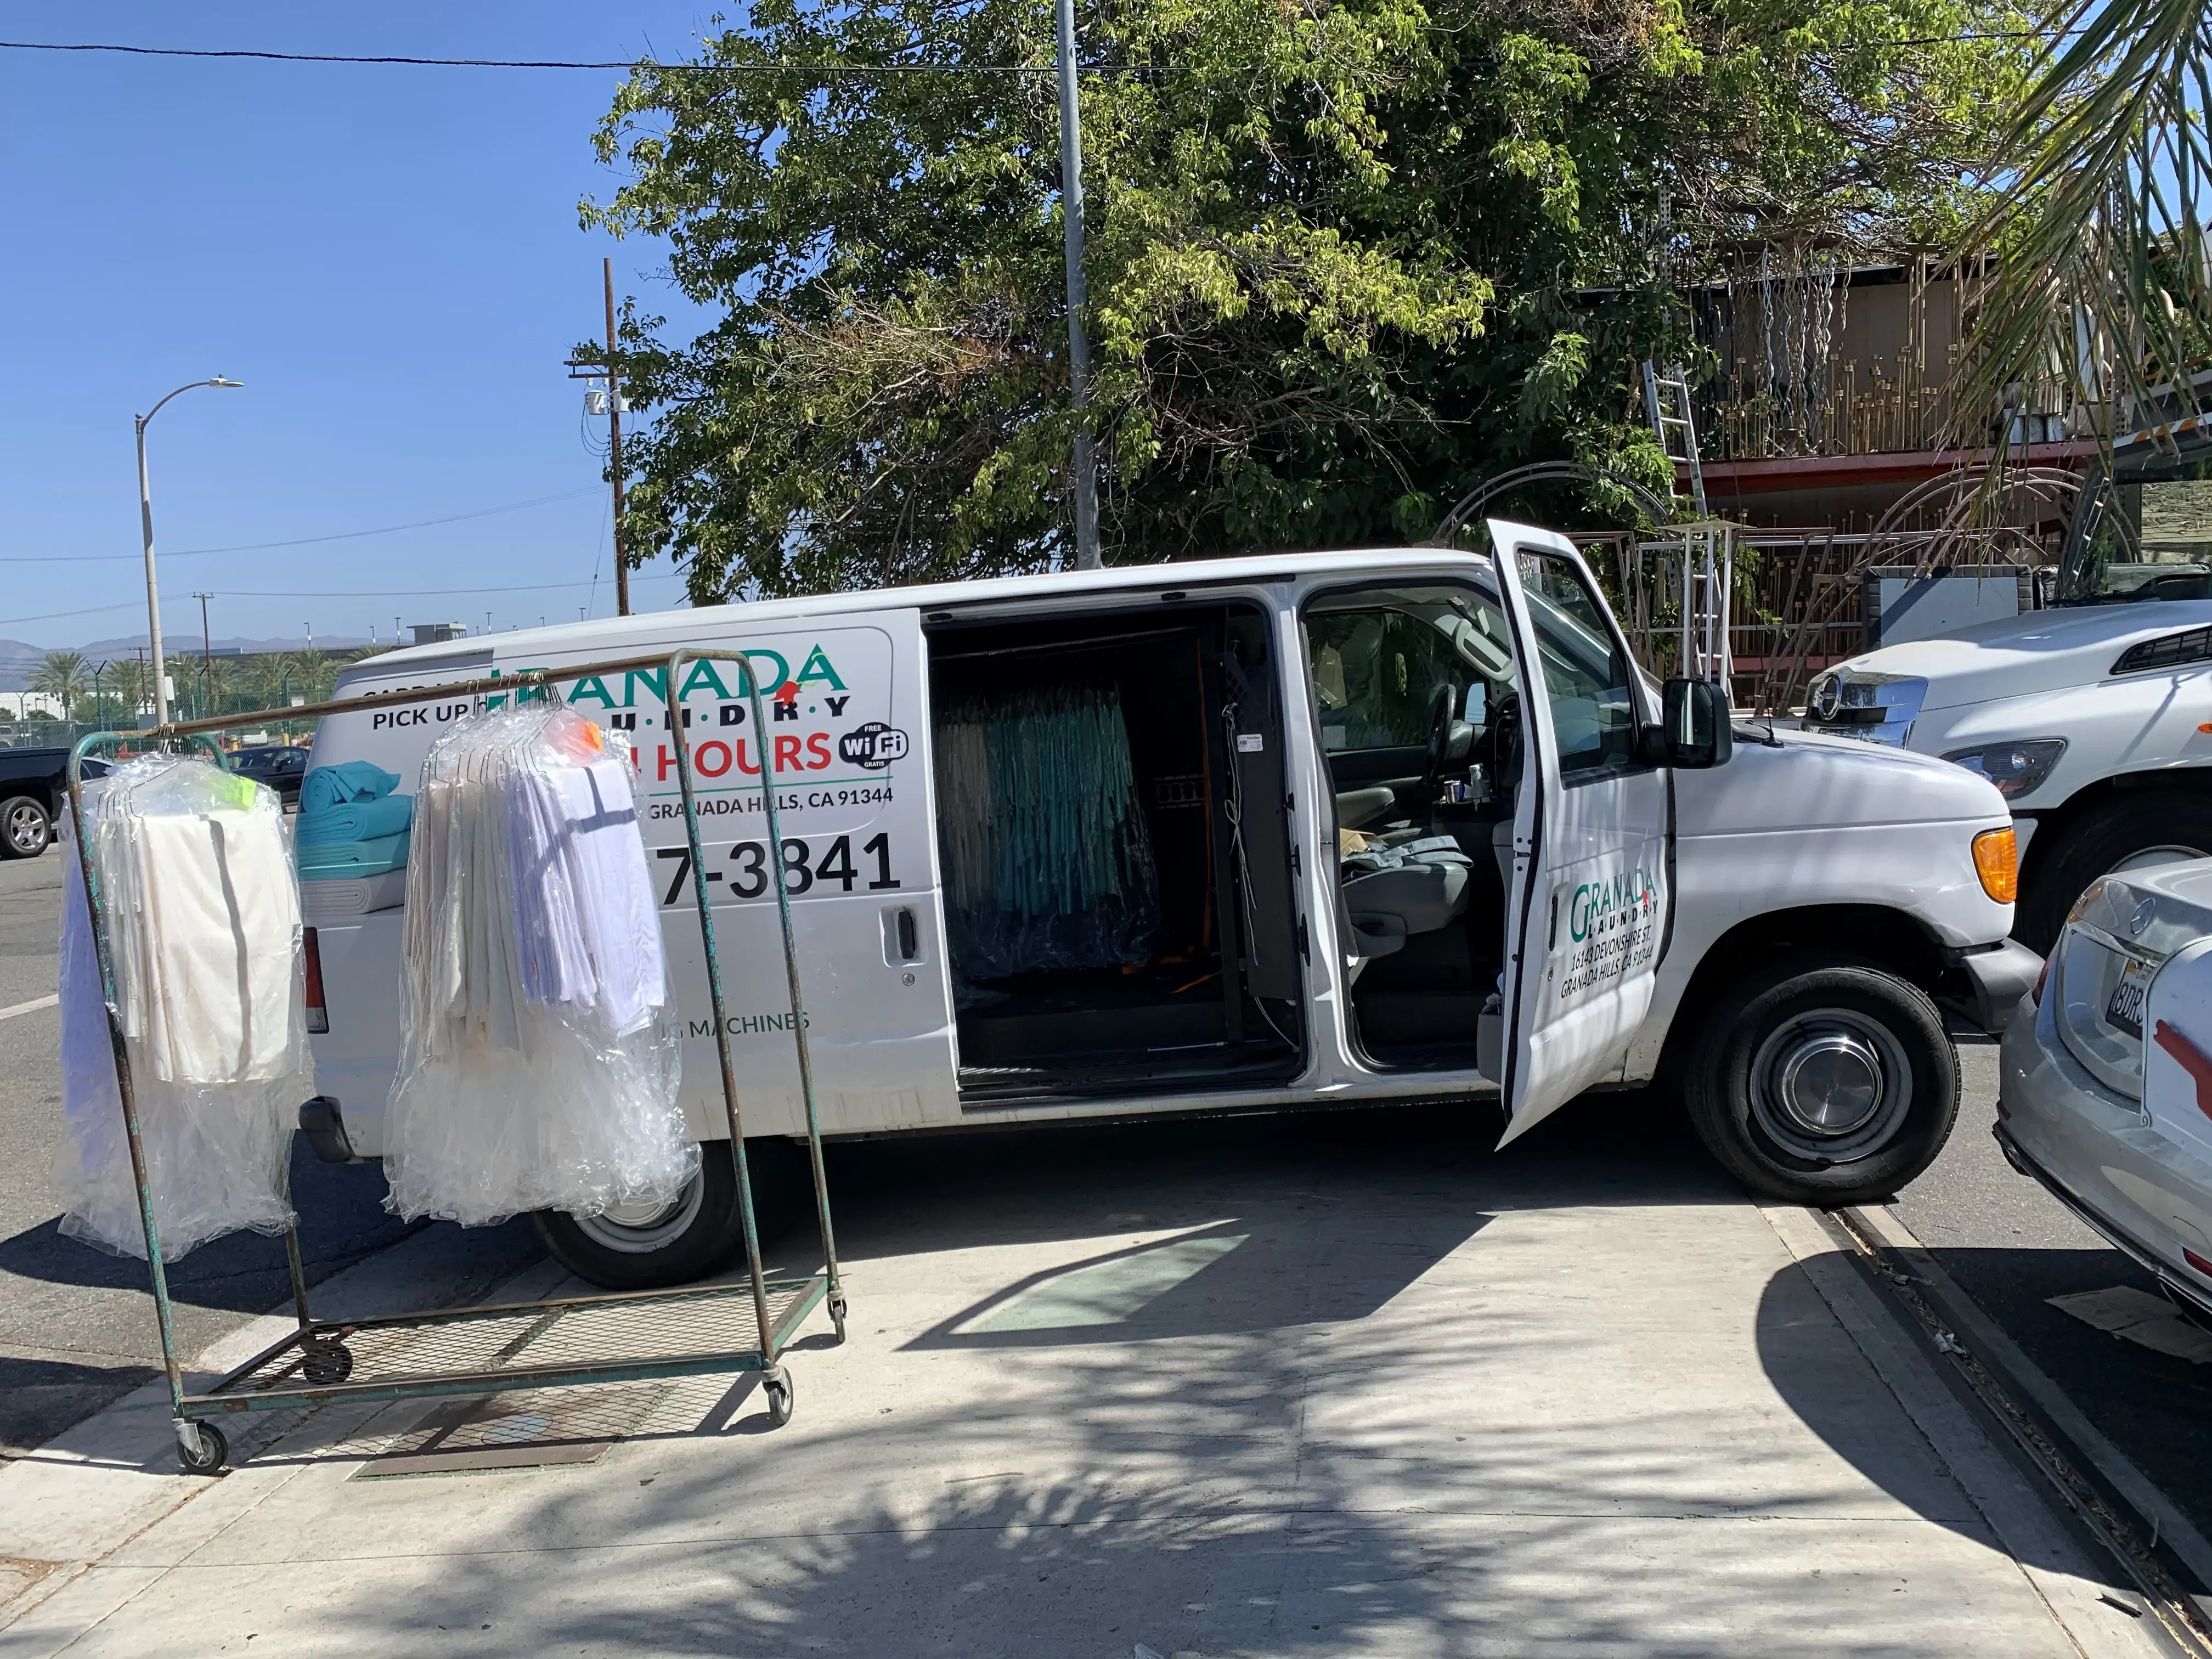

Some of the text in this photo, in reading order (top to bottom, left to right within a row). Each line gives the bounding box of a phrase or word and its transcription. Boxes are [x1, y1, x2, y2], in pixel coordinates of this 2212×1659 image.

[373, 708, 428, 730] PICK
[436, 704, 469, 723] UP
[657, 732, 832, 782] HOURS
[808, 792, 834, 808] CA
[838, 787, 894, 806] 91344
[649, 832, 901, 906] 7-3841
[1570, 865, 1657, 943] GRANADA
[1561, 945, 1654, 998] GRANADA HILLS, CA 91344
[1571, 925, 1651, 972] 16143 DEVONSHIRE ST.
[689, 1012, 810, 1038] MCHINES
[2114, 982, 2143, 1024] 8DR
